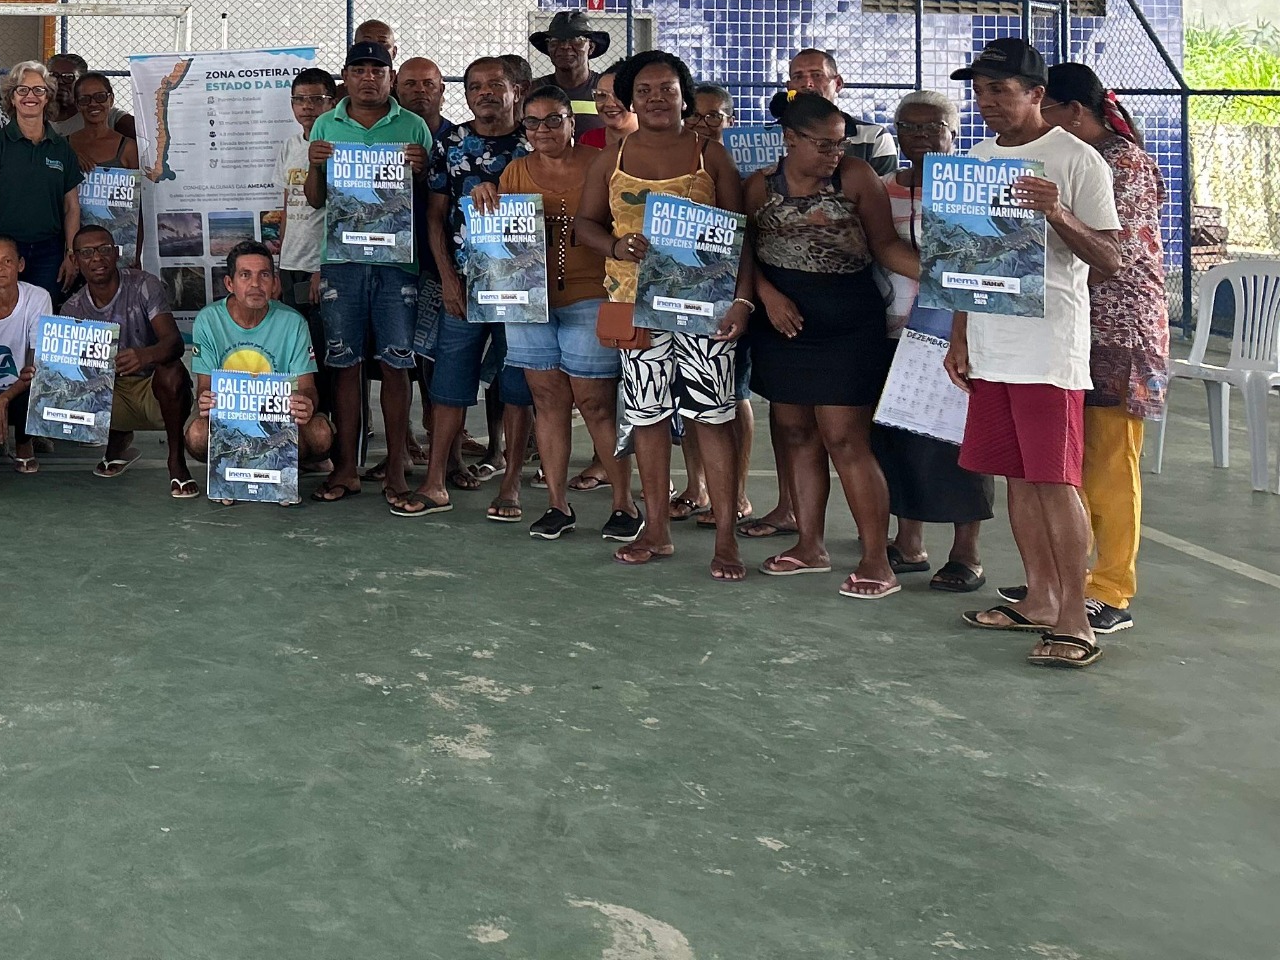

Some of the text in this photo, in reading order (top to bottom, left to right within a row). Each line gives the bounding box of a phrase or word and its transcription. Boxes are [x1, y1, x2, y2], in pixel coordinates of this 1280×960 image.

[206, 70, 235, 79] ZONA
[238, 68, 290, 77] COSTEIRA
[206, 81, 251, 91] ESTADO
[255, 80, 272, 89] DA
[334, 148, 405, 165] CALENDÁRIO
[732, 148, 751, 163] DO
[81, 172, 135, 187] ALENDÁRIO
[333, 164, 404, 180] DO DEFESO
[93, 184, 134, 200] DEFESO
[334, 179, 404, 190] DE ESPÉCIES MARINHAS
[931, 181, 957, 202] DO
[107, 200, 133, 208] MARINHAS
[932, 202, 1034, 219] DE ESPÉCIES MARINHAS
[652, 201, 737, 231] CALENDÁRIO
[470, 217, 536, 235] DO DEFESO
[651, 217, 734, 246] DO DEFESO
[502, 235, 536, 243] MARINHAS
[651, 236, 732, 255] DE ESPÉCIES MARINHAS
[947, 275, 978, 285] inema
[43, 322, 112, 344] CALENDÁRIO
[907, 331, 949, 349] DEZEMBRO
[41, 336, 110, 360] DO DEFESO
[41, 353, 109, 369] DE ESPÉCIES MARINHAS
[218, 378, 291, 396] CALENDÁRIO
[217, 393, 291, 414] DO DEFESO
[218, 411, 290, 423] DE ESPÉCIES MARINHAS
